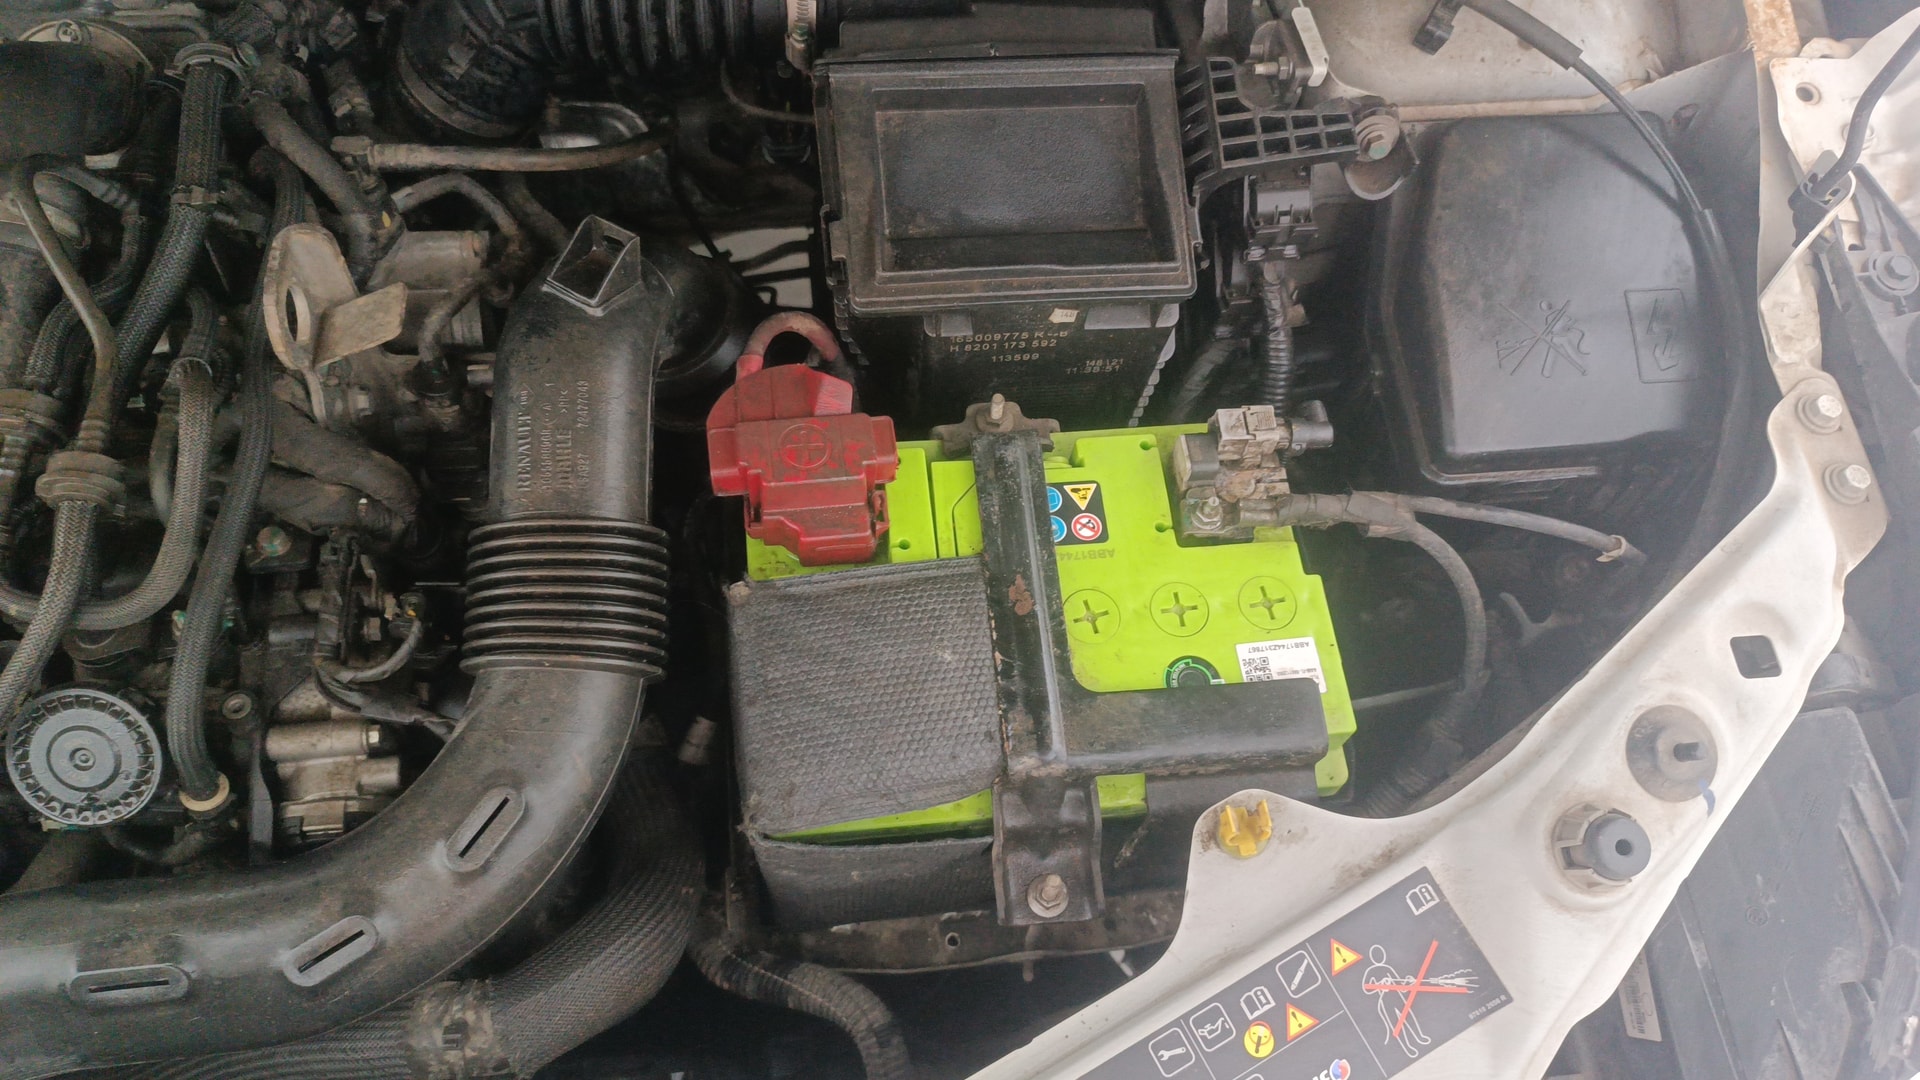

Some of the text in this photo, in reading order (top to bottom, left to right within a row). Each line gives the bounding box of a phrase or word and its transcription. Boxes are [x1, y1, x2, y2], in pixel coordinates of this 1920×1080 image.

[950, 338, 1057, 353] H 8201 173 592
[517, 410, 532, 491] RENAULT
